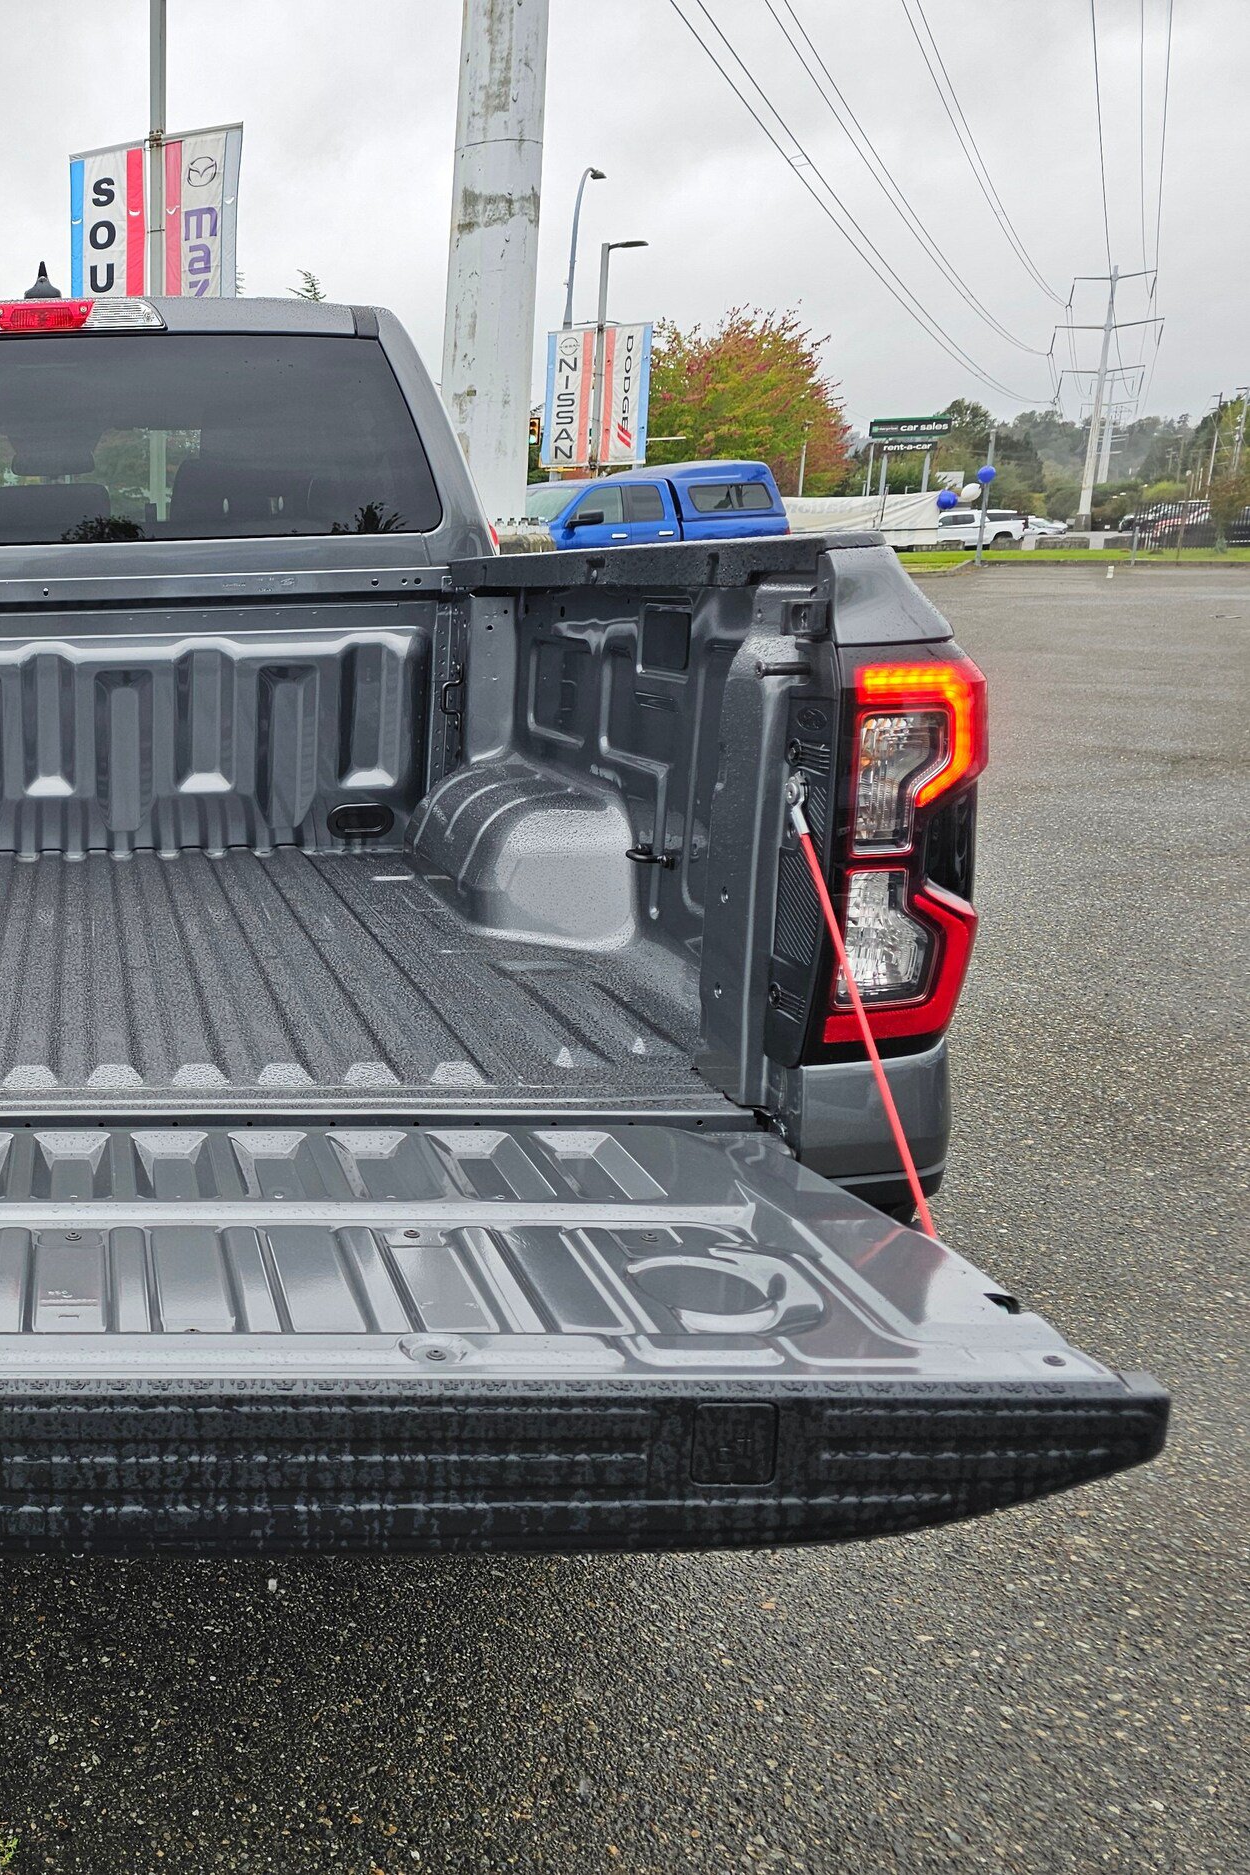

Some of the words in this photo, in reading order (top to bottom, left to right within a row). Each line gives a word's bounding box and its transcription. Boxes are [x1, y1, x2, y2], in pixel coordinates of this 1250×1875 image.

[554, 357, 578, 460] NISSAN
[621, 335, 634, 432] DODGE
[883, 443, 932, 452] rent-a-car
[900, 424, 919, 432] car
[920, 422, 949, 431] sales
